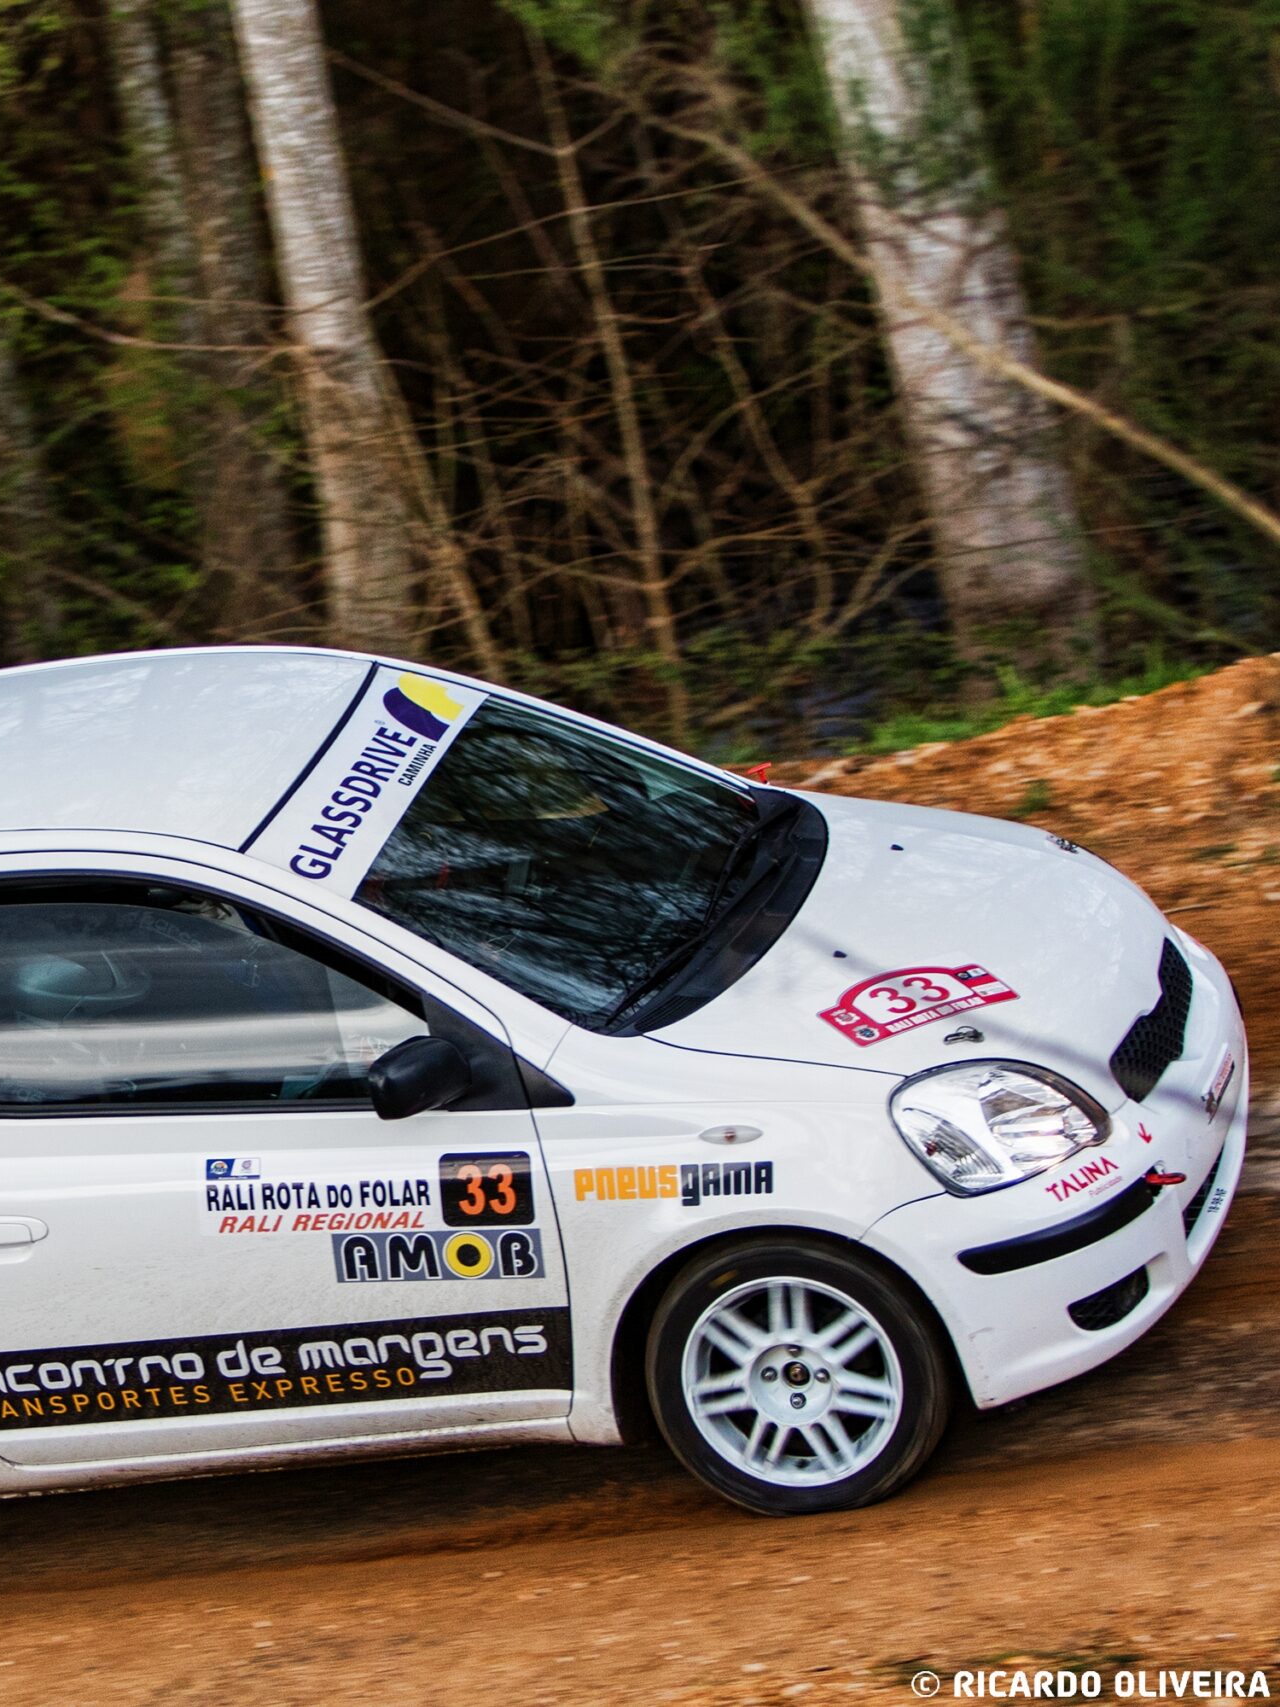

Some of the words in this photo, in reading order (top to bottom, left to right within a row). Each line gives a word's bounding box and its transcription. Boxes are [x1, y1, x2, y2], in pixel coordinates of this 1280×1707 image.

[398, 743, 437, 787] CAMINHA
[289, 726, 417, 879] GLASSDRIVE
[869, 976, 950, 1013] 33
[261, 1182, 321, 1210] ROTA
[326, 1184, 353, 1209] DO
[359, 1179, 431, 1207] FOLAR
[457, 1164, 516, 1216] 33
[1045, 1156, 1119, 1201] TALINA
[219, 1215, 283, 1233] RALI
[291, 1211, 425, 1231] REGIONAL
[341, 1230, 538, 1281] AMOB
[216, 1339, 286, 1379] de
[298, 1325, 548, 1379] margens
[228, 1367, 415, 1402] EXPRESSO
